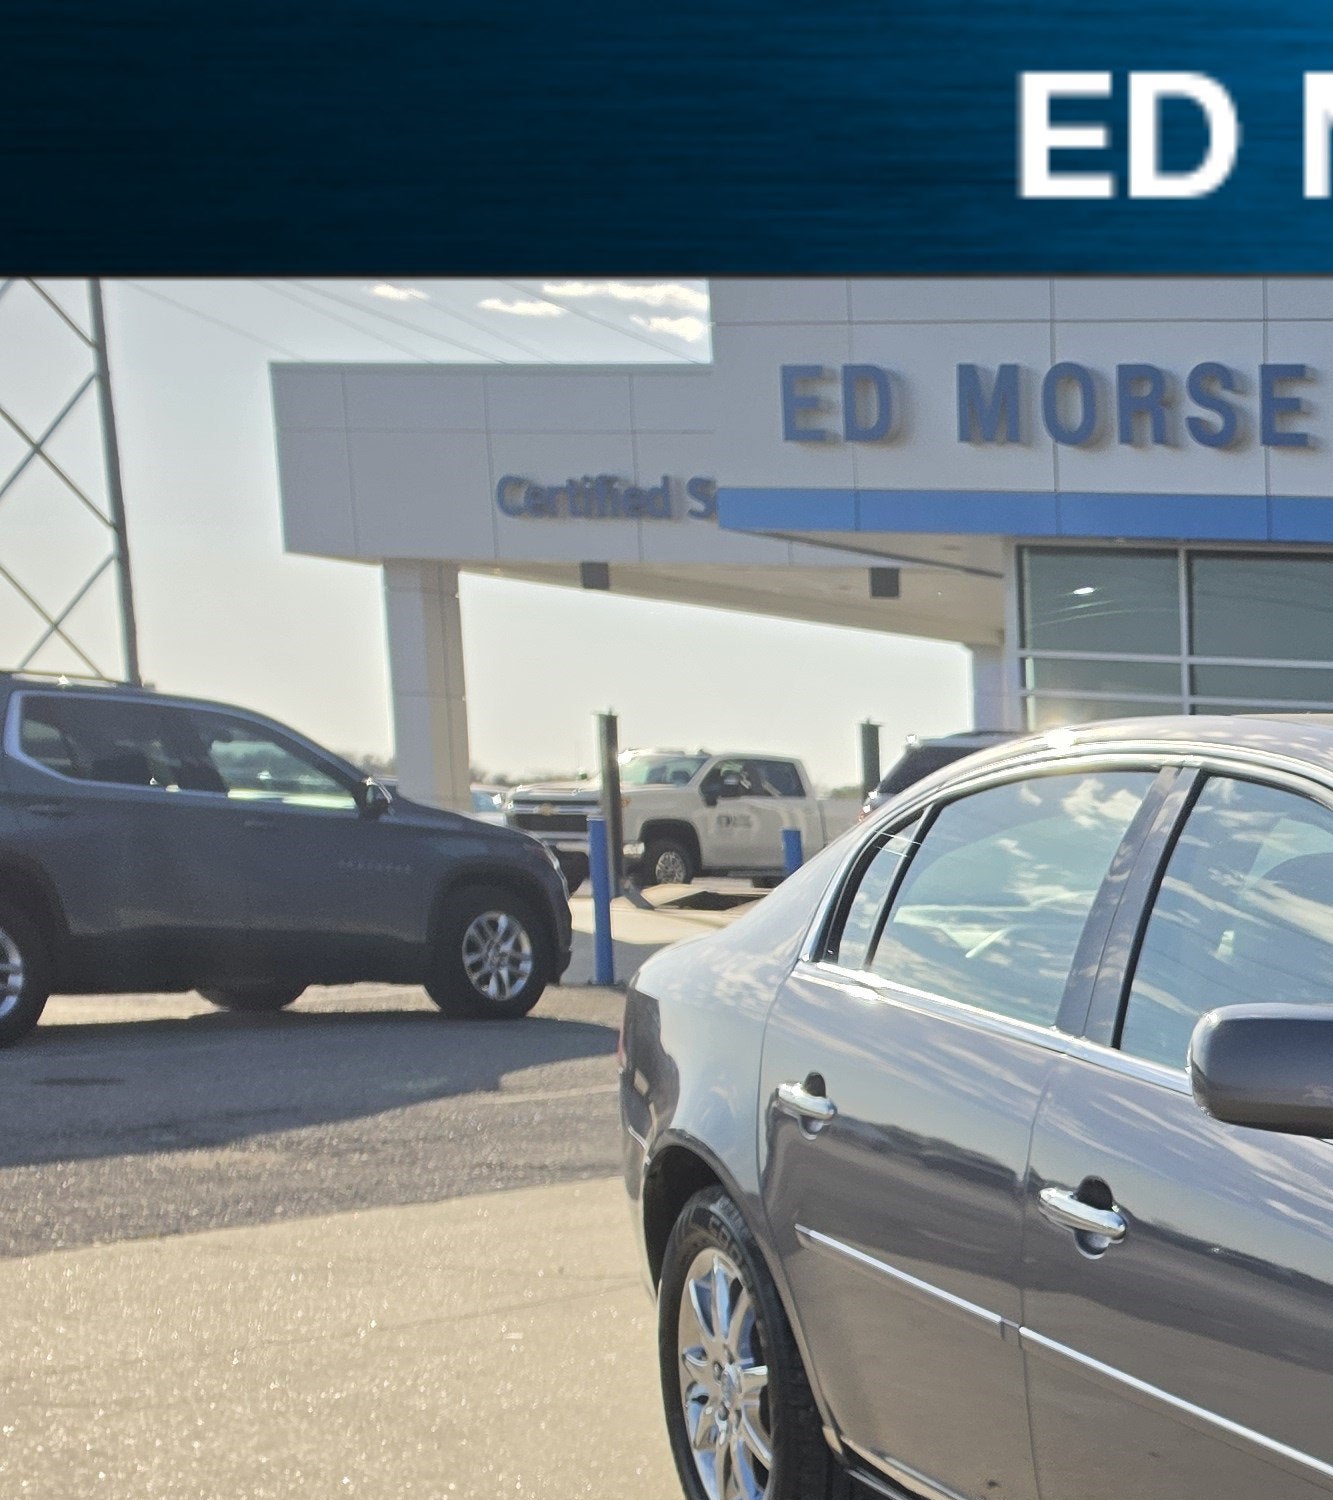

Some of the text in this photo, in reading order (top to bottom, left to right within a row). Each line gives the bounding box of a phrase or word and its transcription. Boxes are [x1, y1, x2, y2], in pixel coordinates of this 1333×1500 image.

[780, 361, 1310, 449] ED MORSE
[497, 474, 673, 520] Certified
